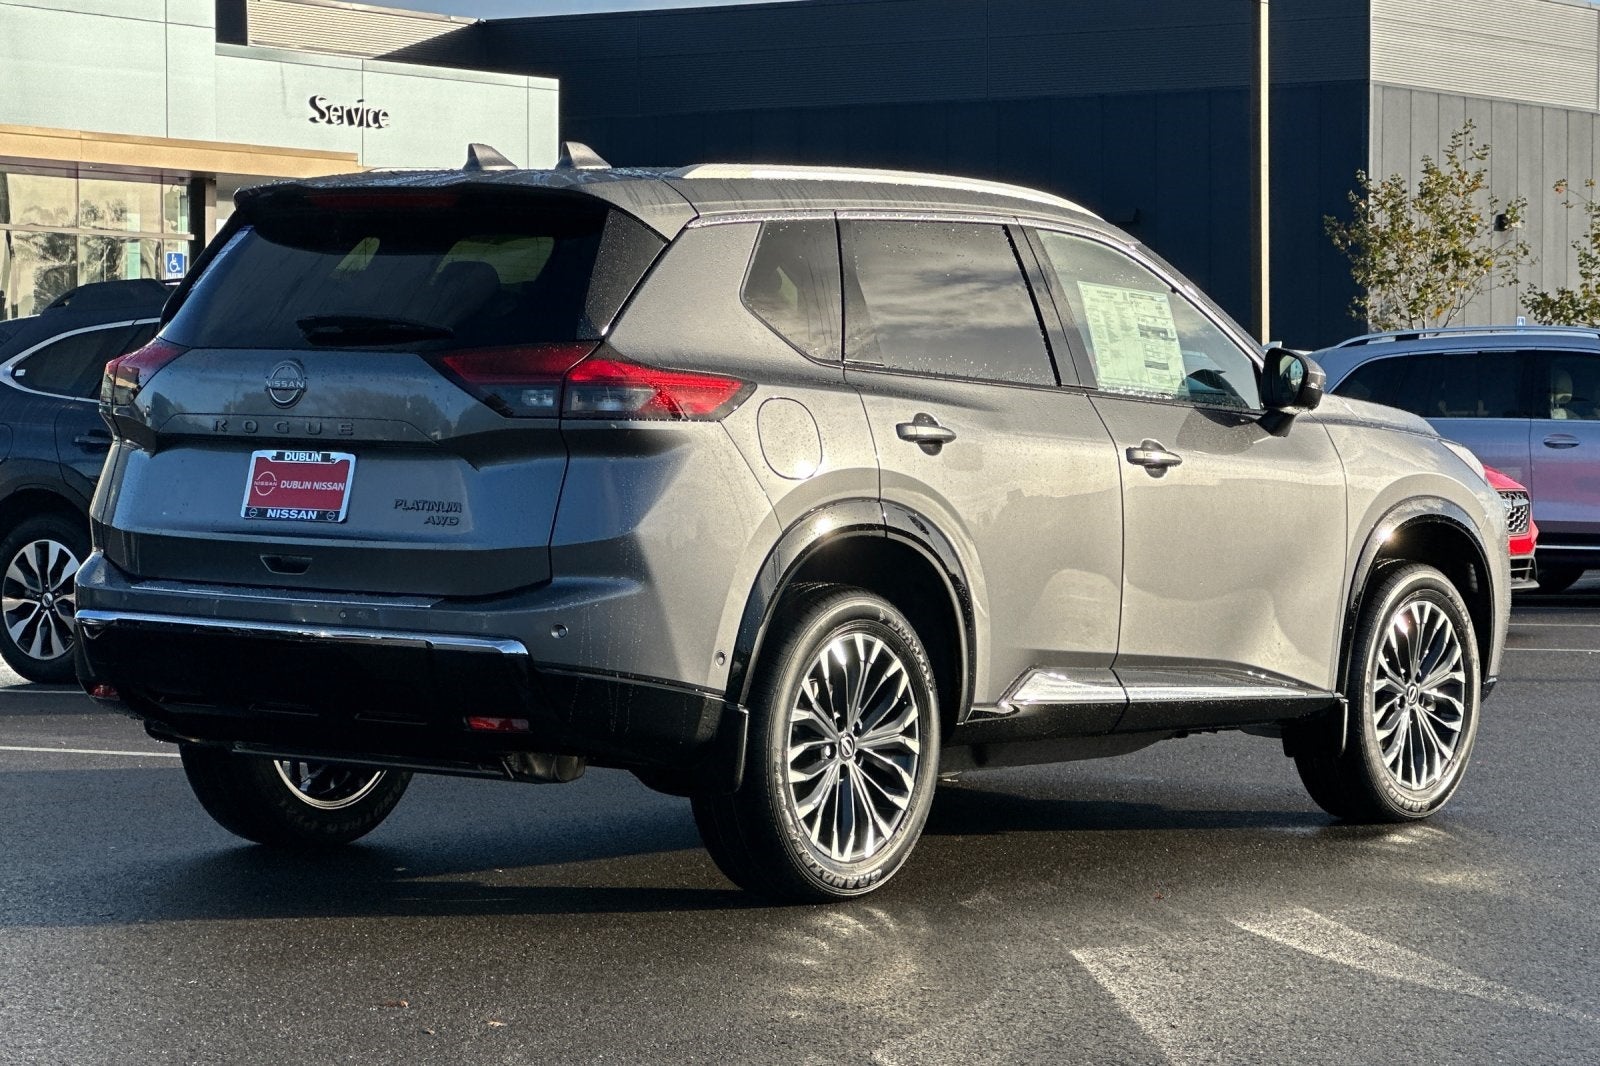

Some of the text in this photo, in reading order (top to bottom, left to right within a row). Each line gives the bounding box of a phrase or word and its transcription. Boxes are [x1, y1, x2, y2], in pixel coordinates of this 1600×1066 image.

[307, 94, 390, 129] Service
[265, 379, 305, 389] NISSAN
[213, 419, 354, 436] ROGUE
[284, 451, 322, 462] DUBLIN
[280, 480, 345, 491] DUBLIN NISSAN
[393, 498, 463, 513] PLATINUM
[266, 509, 318, 520] NISSAN
[423, 515, 460, 527] AWD
